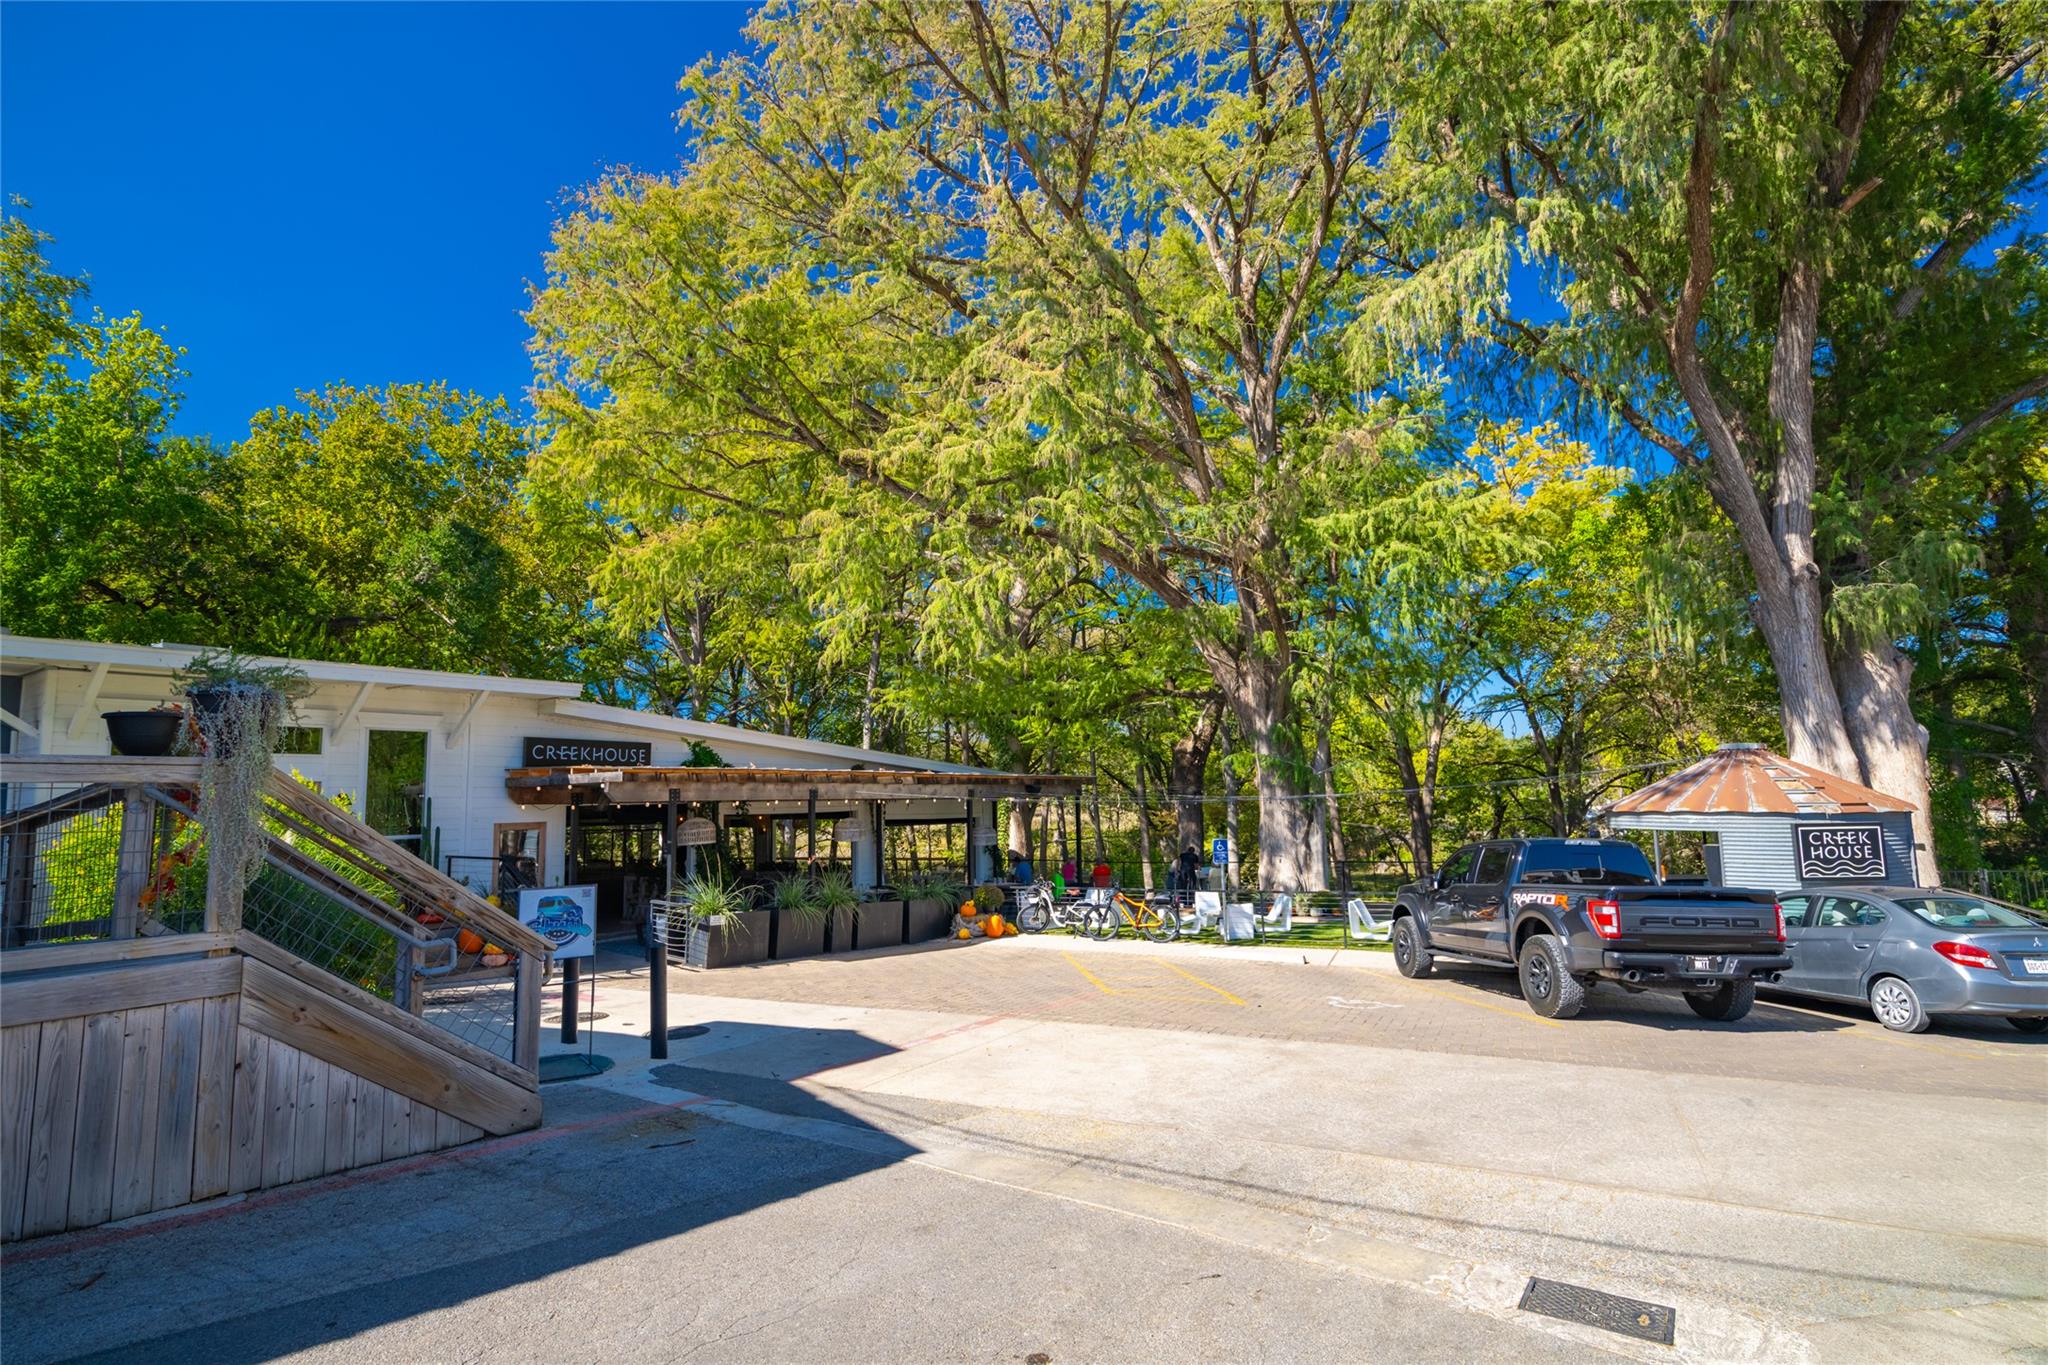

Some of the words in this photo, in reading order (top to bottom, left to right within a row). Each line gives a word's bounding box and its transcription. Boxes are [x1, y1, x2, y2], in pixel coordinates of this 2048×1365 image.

[532, 744, 646, 763] CREEKHOUSE
[1808, 831, 1871, 845] CREEK
[1810, 845, 1873, 859] HOUSE
[1513, 893, 1569, 911] RAPTOR
[1640, 916, 1760, 928] FORD
